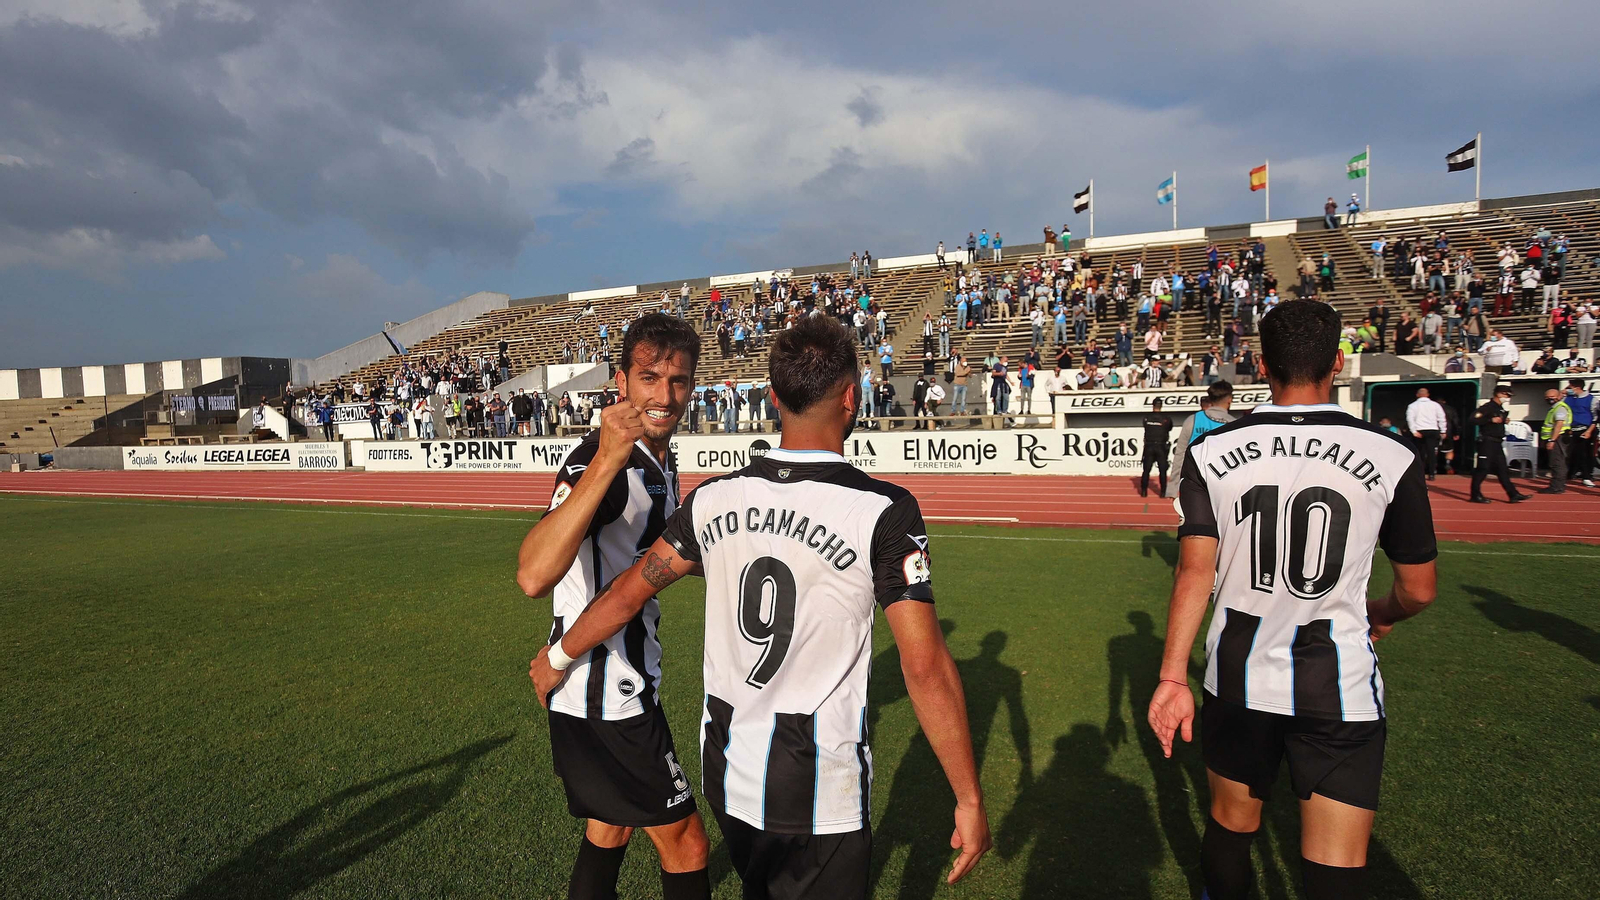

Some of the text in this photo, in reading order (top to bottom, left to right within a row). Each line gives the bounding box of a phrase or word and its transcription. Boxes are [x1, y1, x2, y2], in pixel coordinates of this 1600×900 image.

[171, 395, 236, 412] ETERNO PRESIDENTE
[1071, 396, 1125, 408] LEGEA
[1231, 392, 1272, 403] EGE
[454, 441, 518, 460] PRINT
[549, 444, 571, 452] PINT
[669, 442, 679, 450] AS
[903, 438, 997, 466] El Monje
[1062, 432, 1138, 463] Rojas
[131, 453, 158, 468] aqualia
[203, 450, 245, 463] LEGEA
[246, 448, 291, 462] LEGEA
[298, 455, 338, 468] BARROSO
[368, 449, 413, 460] FOOTTERS.
[697, 450, 745, 468] GPON
[848, 459, 877, 467] ANTE
[913, 461, 962, 469] FERRETERÍA
[1207, 436, 1383, 493] LUIS ALCALDE
[646, 484, 667, 495] EGEA
[701, 506, 858, 572] PITO CAMACHO
[1234, 484, 1352, 600] 10
[738, 555, 797, 690] 9
[664, 751, 688, 792] 5
[666, 785, 692, 809] LEGE
